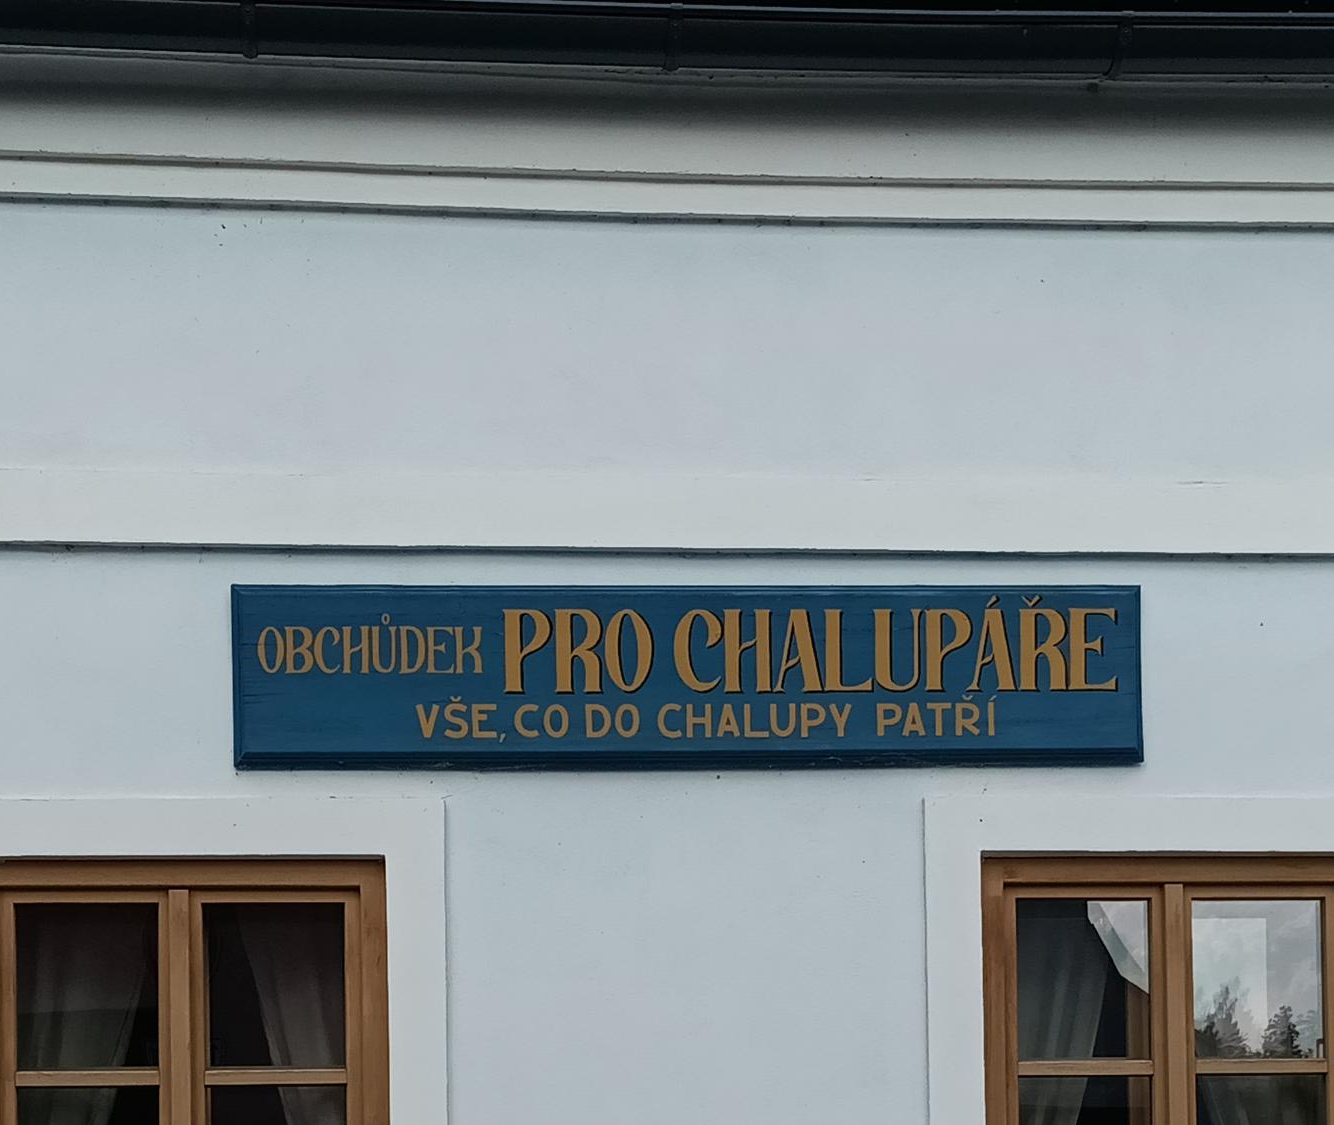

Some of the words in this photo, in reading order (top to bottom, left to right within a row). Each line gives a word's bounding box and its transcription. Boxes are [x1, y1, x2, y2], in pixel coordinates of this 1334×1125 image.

[257, 613, 484, 675] OBCHŮDEK
[502, 608, 655, 694] PRO
[673, 594, 1118, 693] CHALUPÁŘE
[415, 696, 506, 743] VŠE,
[514, 703, 569, 739] CO
[585, 703, 640, 739] DO
[657, 703, 853, 739] CHALUPY
[875, 695, 998, 737] PATŘÍ
